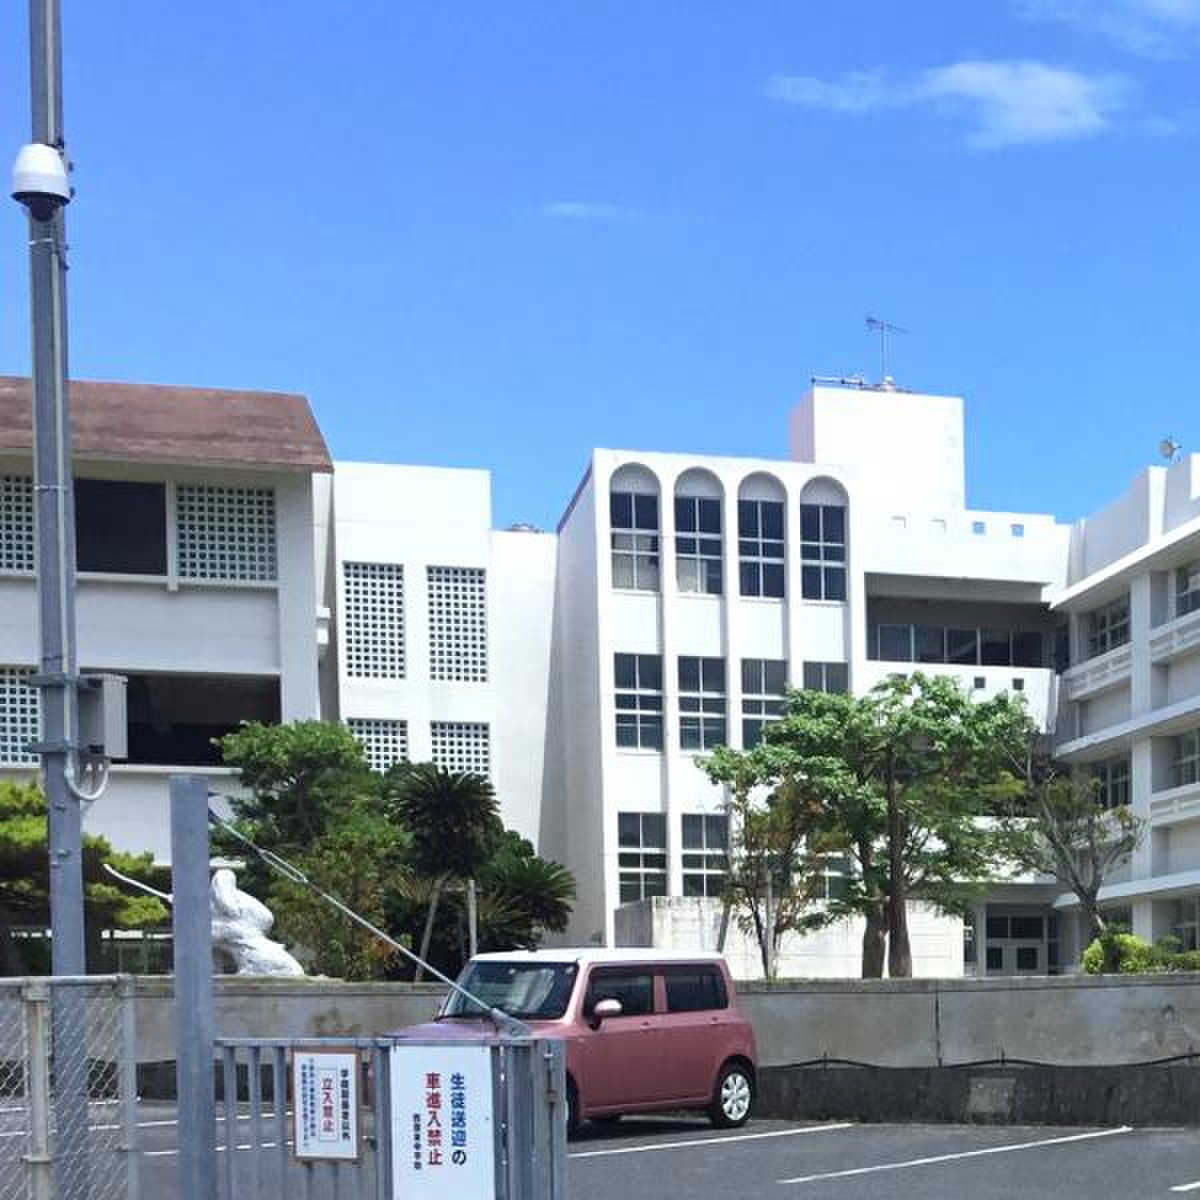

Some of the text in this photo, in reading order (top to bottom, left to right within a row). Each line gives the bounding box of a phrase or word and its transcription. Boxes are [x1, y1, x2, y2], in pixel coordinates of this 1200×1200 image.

[425, 1072, 443, 1166] 車進入禁止
[450, 1072, 467, 1166] 生徒送迎の
